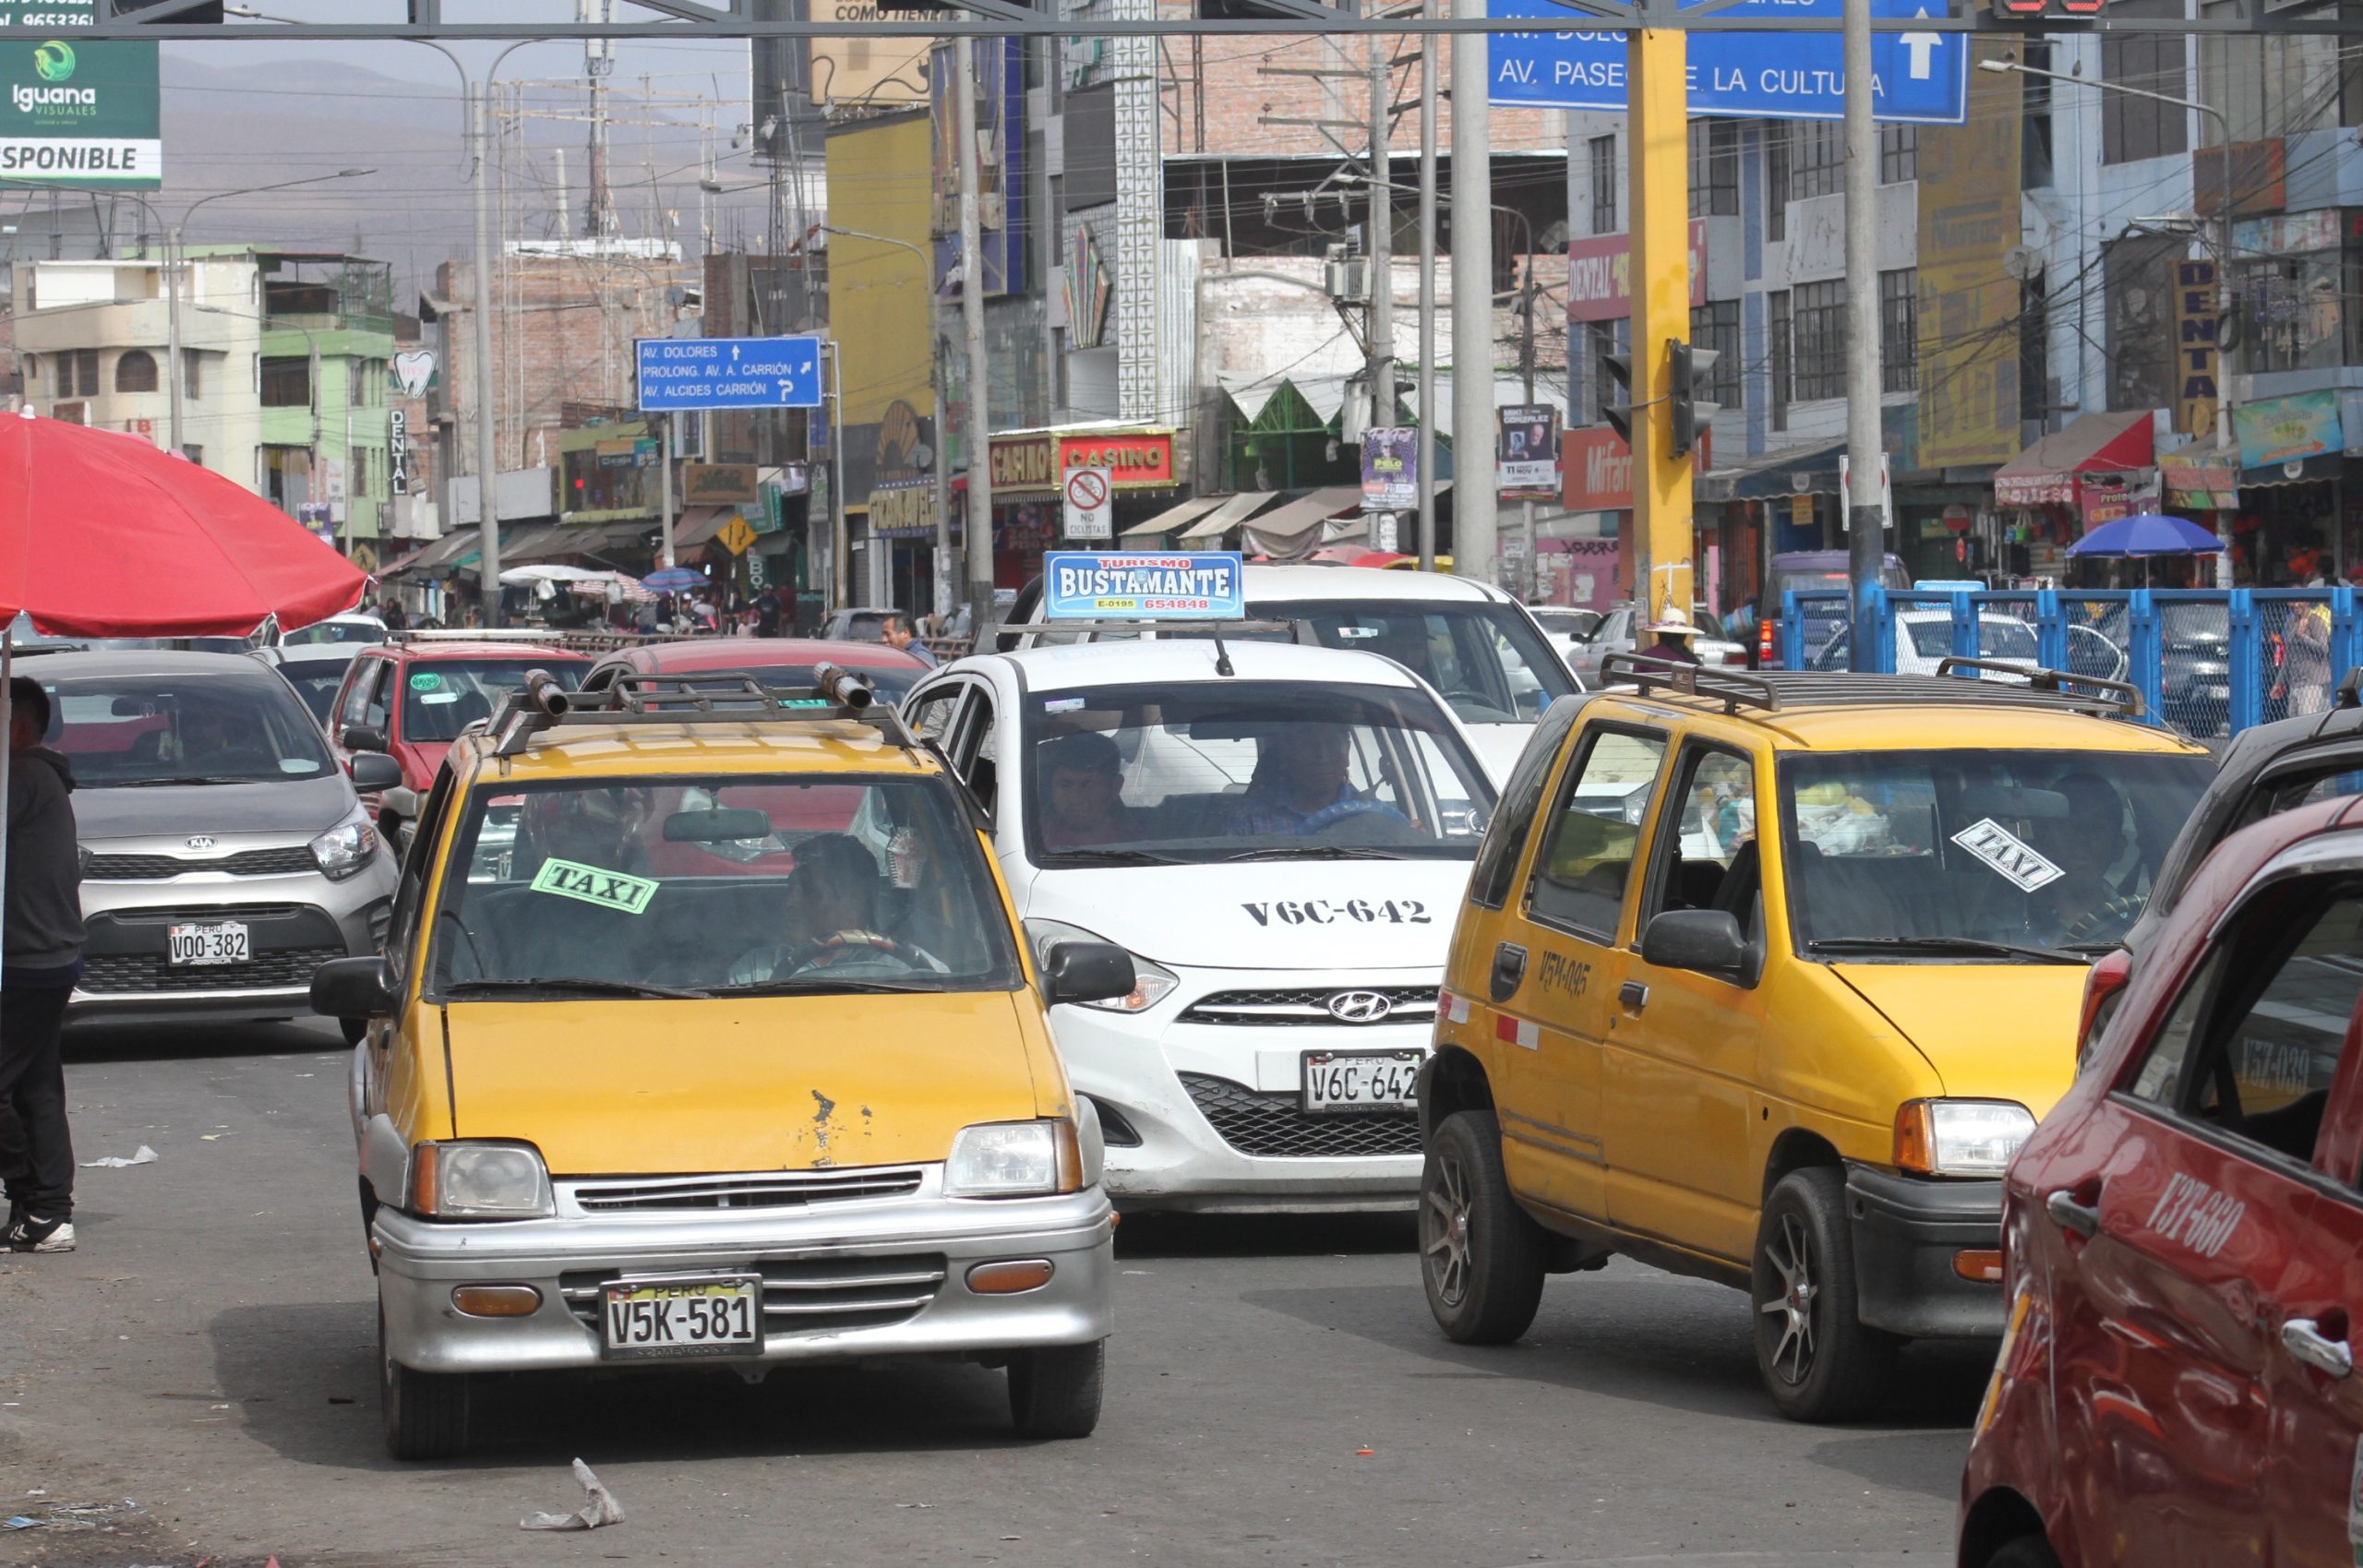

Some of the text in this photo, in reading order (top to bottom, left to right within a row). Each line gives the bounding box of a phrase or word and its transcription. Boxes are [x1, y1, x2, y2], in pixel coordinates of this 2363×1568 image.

[1498, 59, 1538, 85] AV.
[1555, 61, 1627, 87] PASE
[1714, 67, 1747, 91] LA
[1760, 69, 1885, 97] CULTUA
[13, 84, 96, 113] Iguana
[35, 106, 97, 116] VISUALES
[1569, 256, 1611, 303] DENTAL
[642, 346, 717, 359] AV. DOLORES
[2179, 263, 2217, 420] DENTA
[643, 362, 791, 377] PROLONG. AV. A. CARRIÓN
[643, 381, 767, 398] AV. ALCIDES CARRIÓN
[390, 411, 406, 495] DENTAL
[990, 443, 1050, 483] CASINO
[1068, 447, 1163, 468] CASINO
[1586, 441, 1633, 495] Mifar
[1070, 524, 1107, 534] CICLISTAS
[1080, 513, 1095, 523] NO
[1098, 558, 1192, 569] TURISMO
[1060, 567, 1231, 598] BUSTAMANTE
[1098, 599, 1209, 609] E-0195 654848
[190, 839, 213, 847] KIA
[1971, 829, 2047, 881] TAXI
[552, 866, 644, 905] TAXI
[1241, 899, 1432, 927] V6C-642
[195, 925, 222, 934] PERU
[1312, 1066, 1419, 1101] V6C-642
[2145, 1171, 2246, 1259] V3T-660
[611, 1296, 752, 1344] V5K-581
